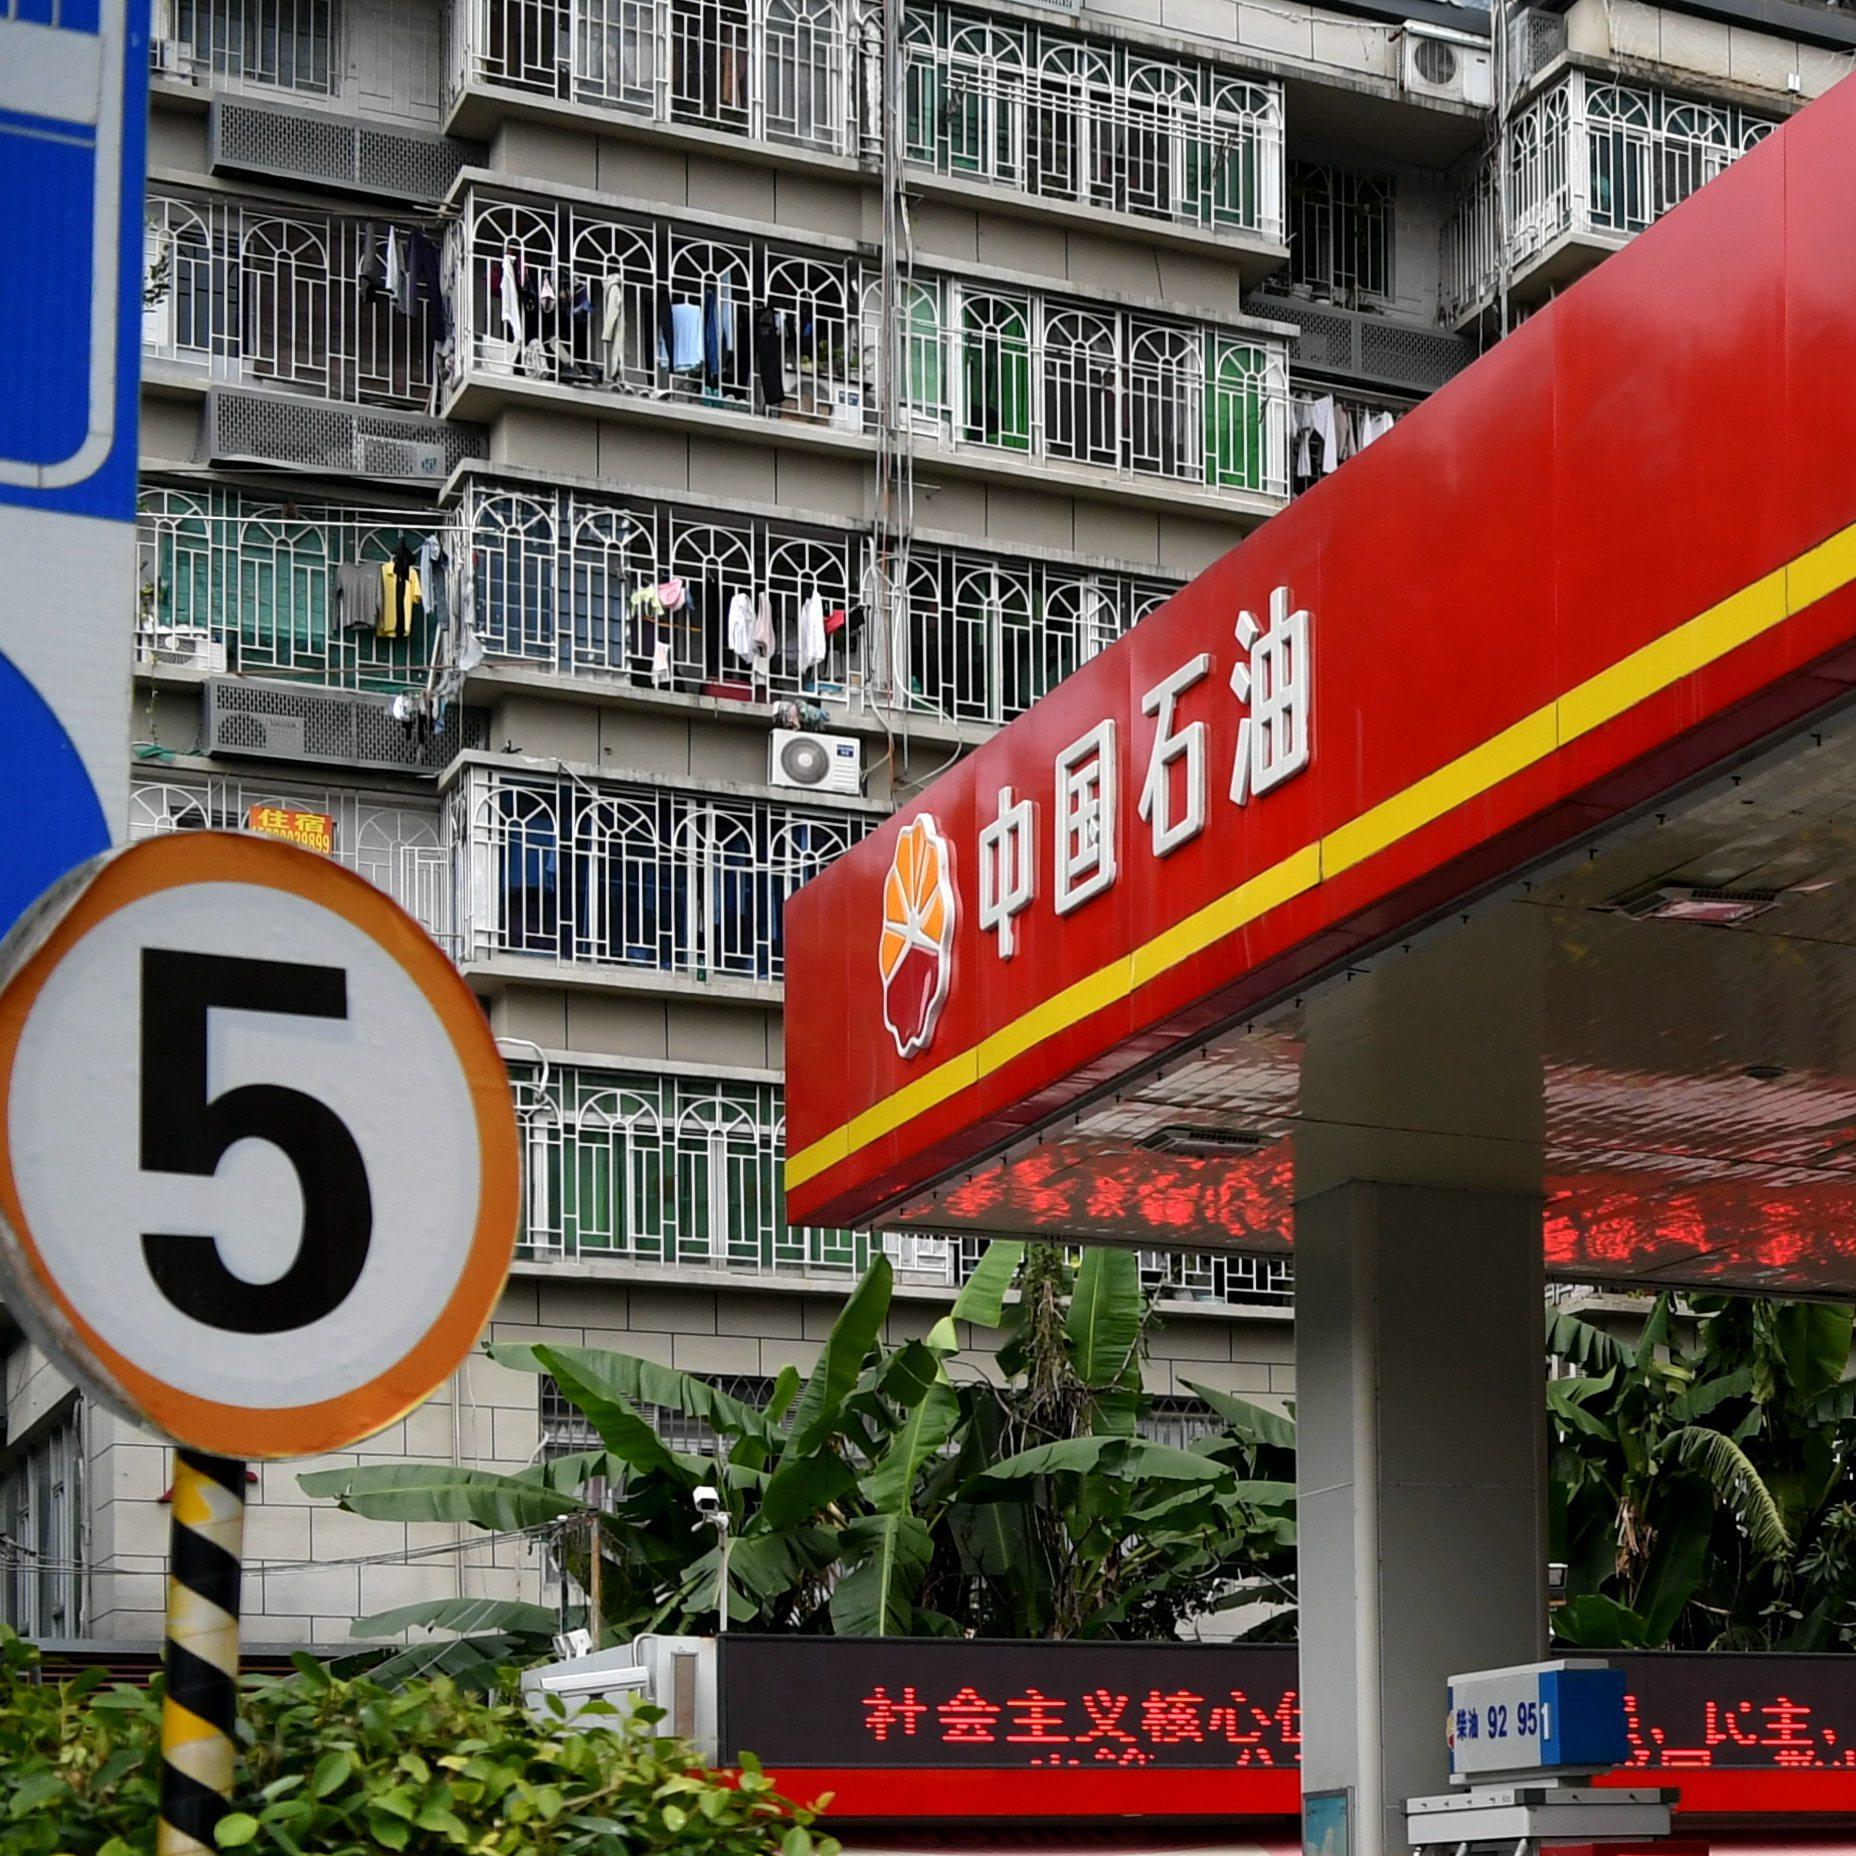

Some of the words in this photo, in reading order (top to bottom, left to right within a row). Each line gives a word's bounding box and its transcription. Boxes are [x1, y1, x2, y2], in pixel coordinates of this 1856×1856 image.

[979, 586, 1311, 960] 中国石油
[139, 947, 374, 1335] 5
[1455, 1704, 1479, 1741] 柴油
[1487, 1704, 1508, 1738] 92
[1517, 1701, 1538, 1736] 95
[1540, 1702, 1550, 1740] 1
